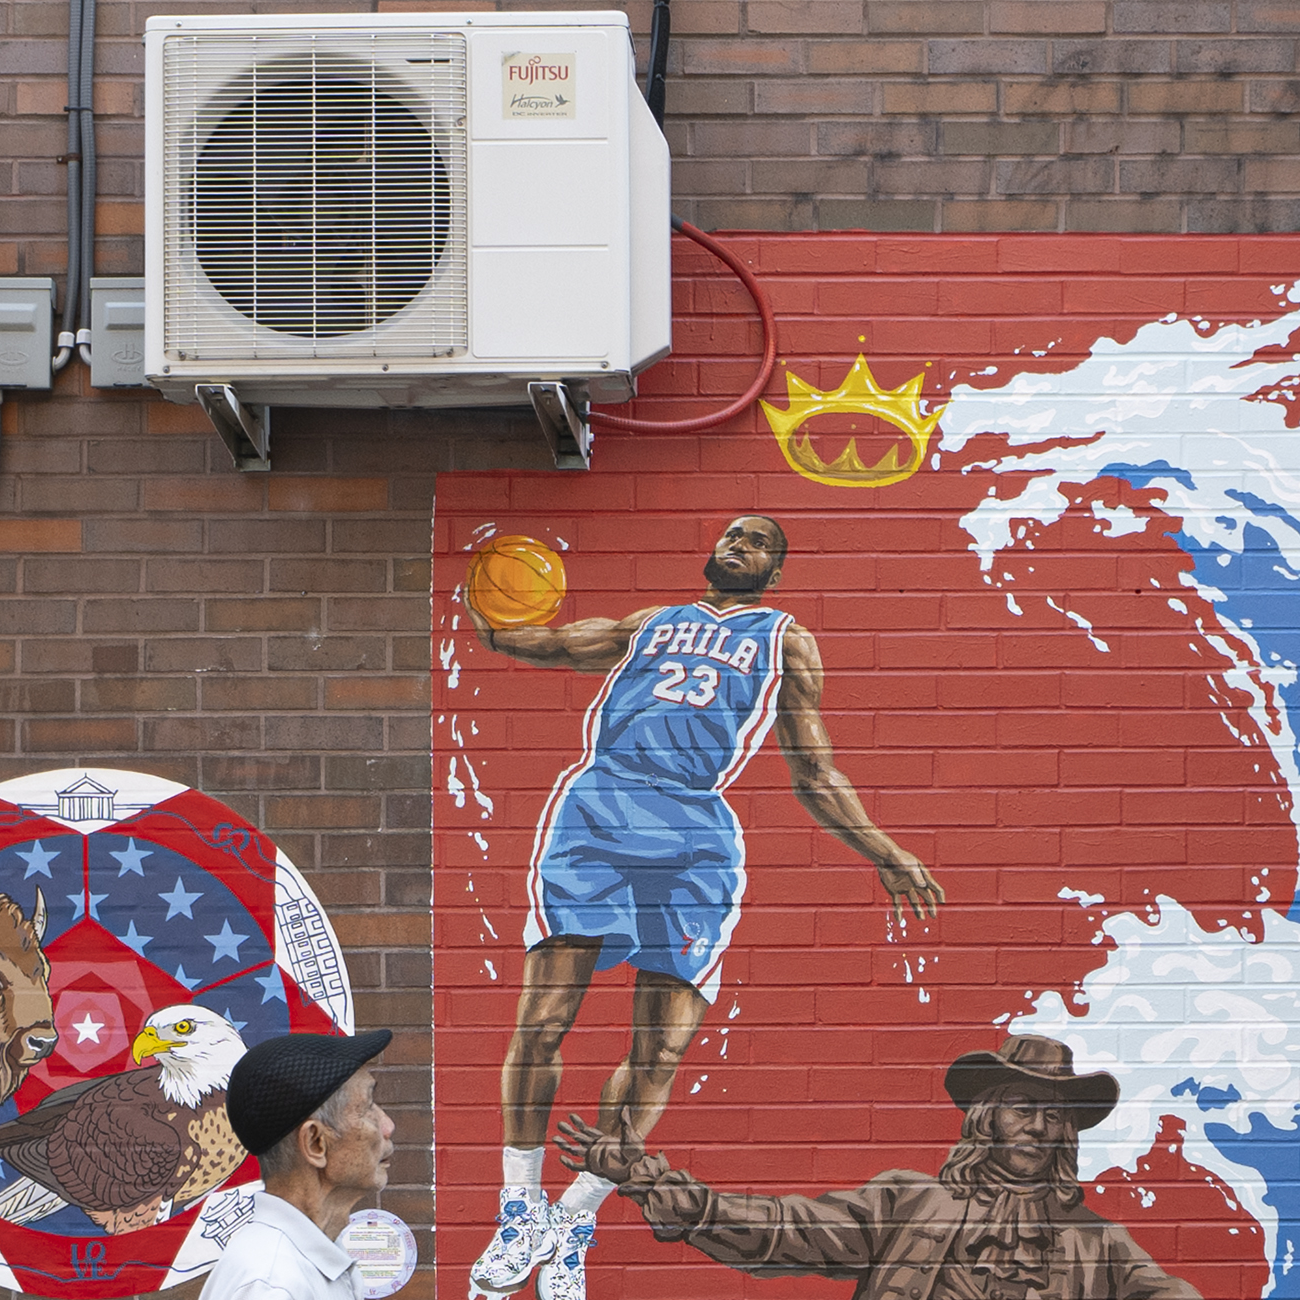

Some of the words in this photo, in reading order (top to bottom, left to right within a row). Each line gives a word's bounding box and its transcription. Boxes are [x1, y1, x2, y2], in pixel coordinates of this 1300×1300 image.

[509, 55, 568, 85] FUJITSU
[510, 93, 553, 110] Halcyon
[643, 622, 760, 675] PHILA
[652, 661, 721, 709] 23
